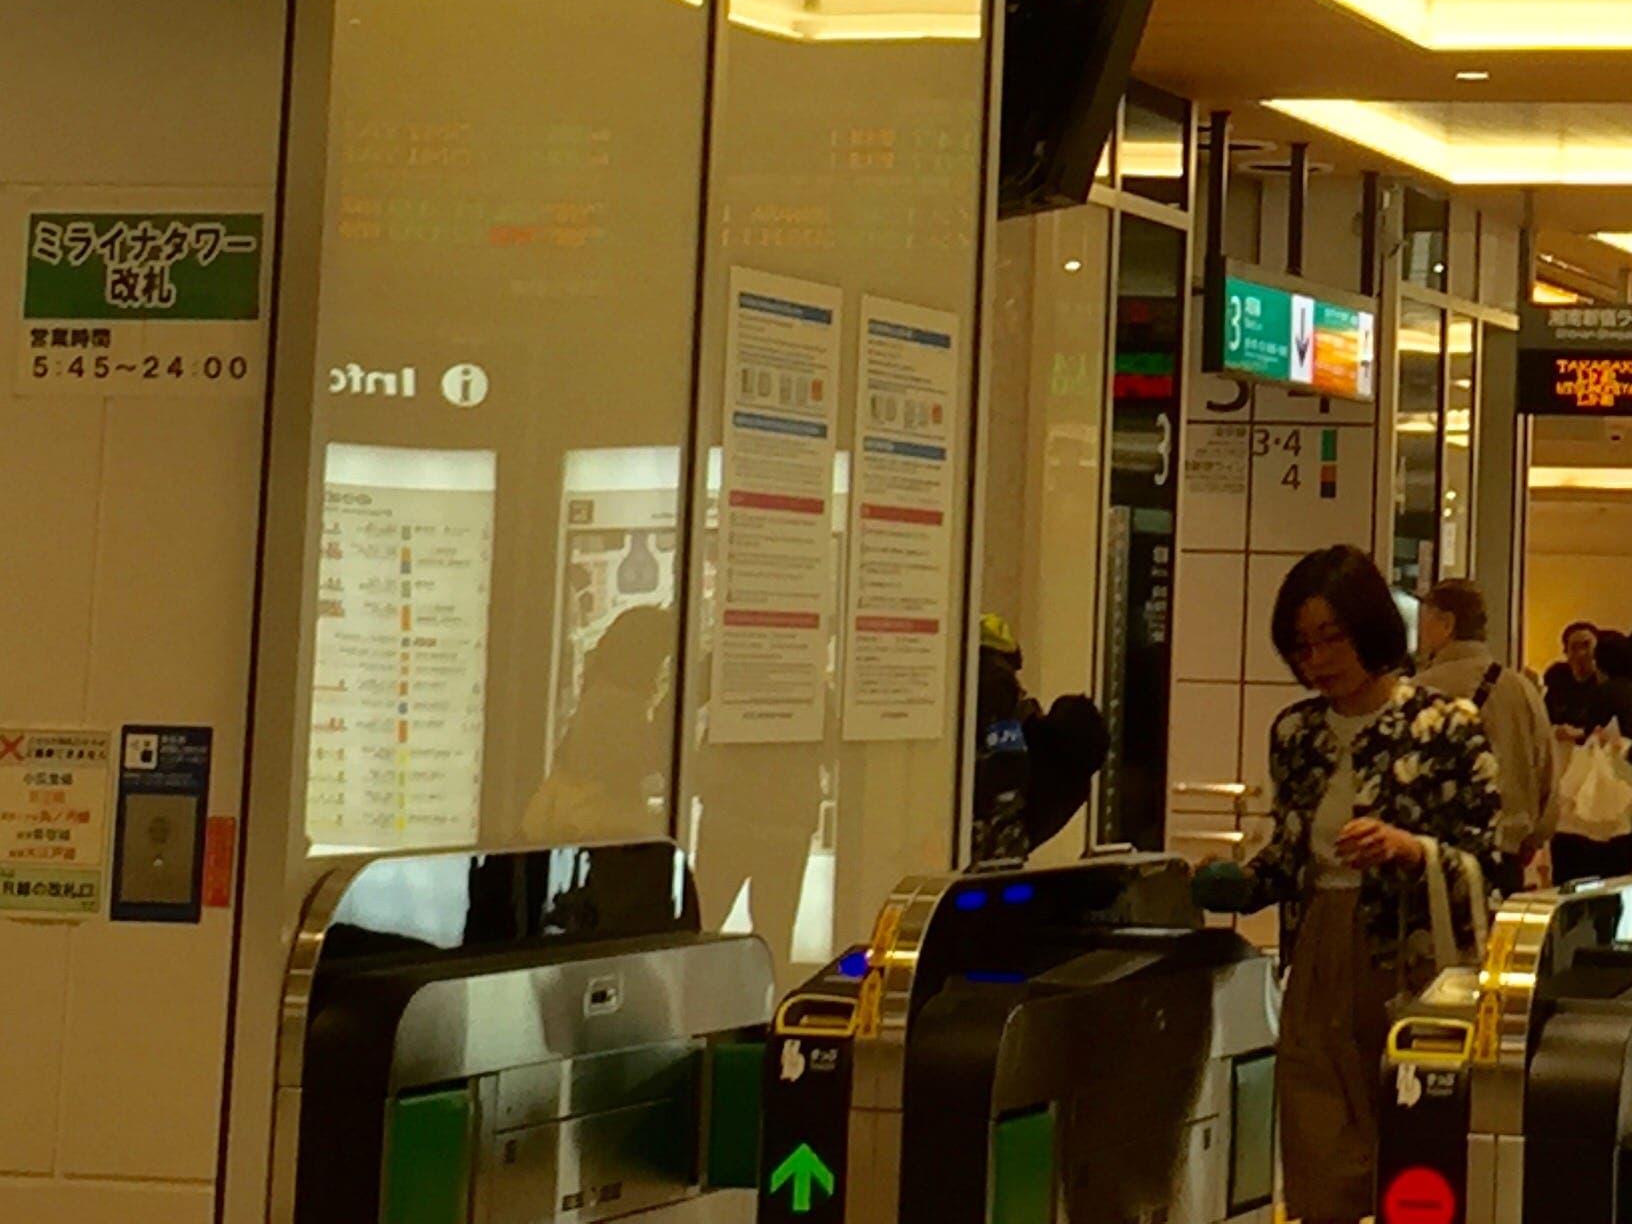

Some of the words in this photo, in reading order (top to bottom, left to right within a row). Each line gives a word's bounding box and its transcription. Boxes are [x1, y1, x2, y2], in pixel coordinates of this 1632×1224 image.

[35, 223, 255, 264] ミライナタワー
[107, 266, 175, 306] 改札
[30, 328, 111, 348] 営業時間
[1228, 294, 1242, 352] 3
[1280, 463, 1302, 490] 4
